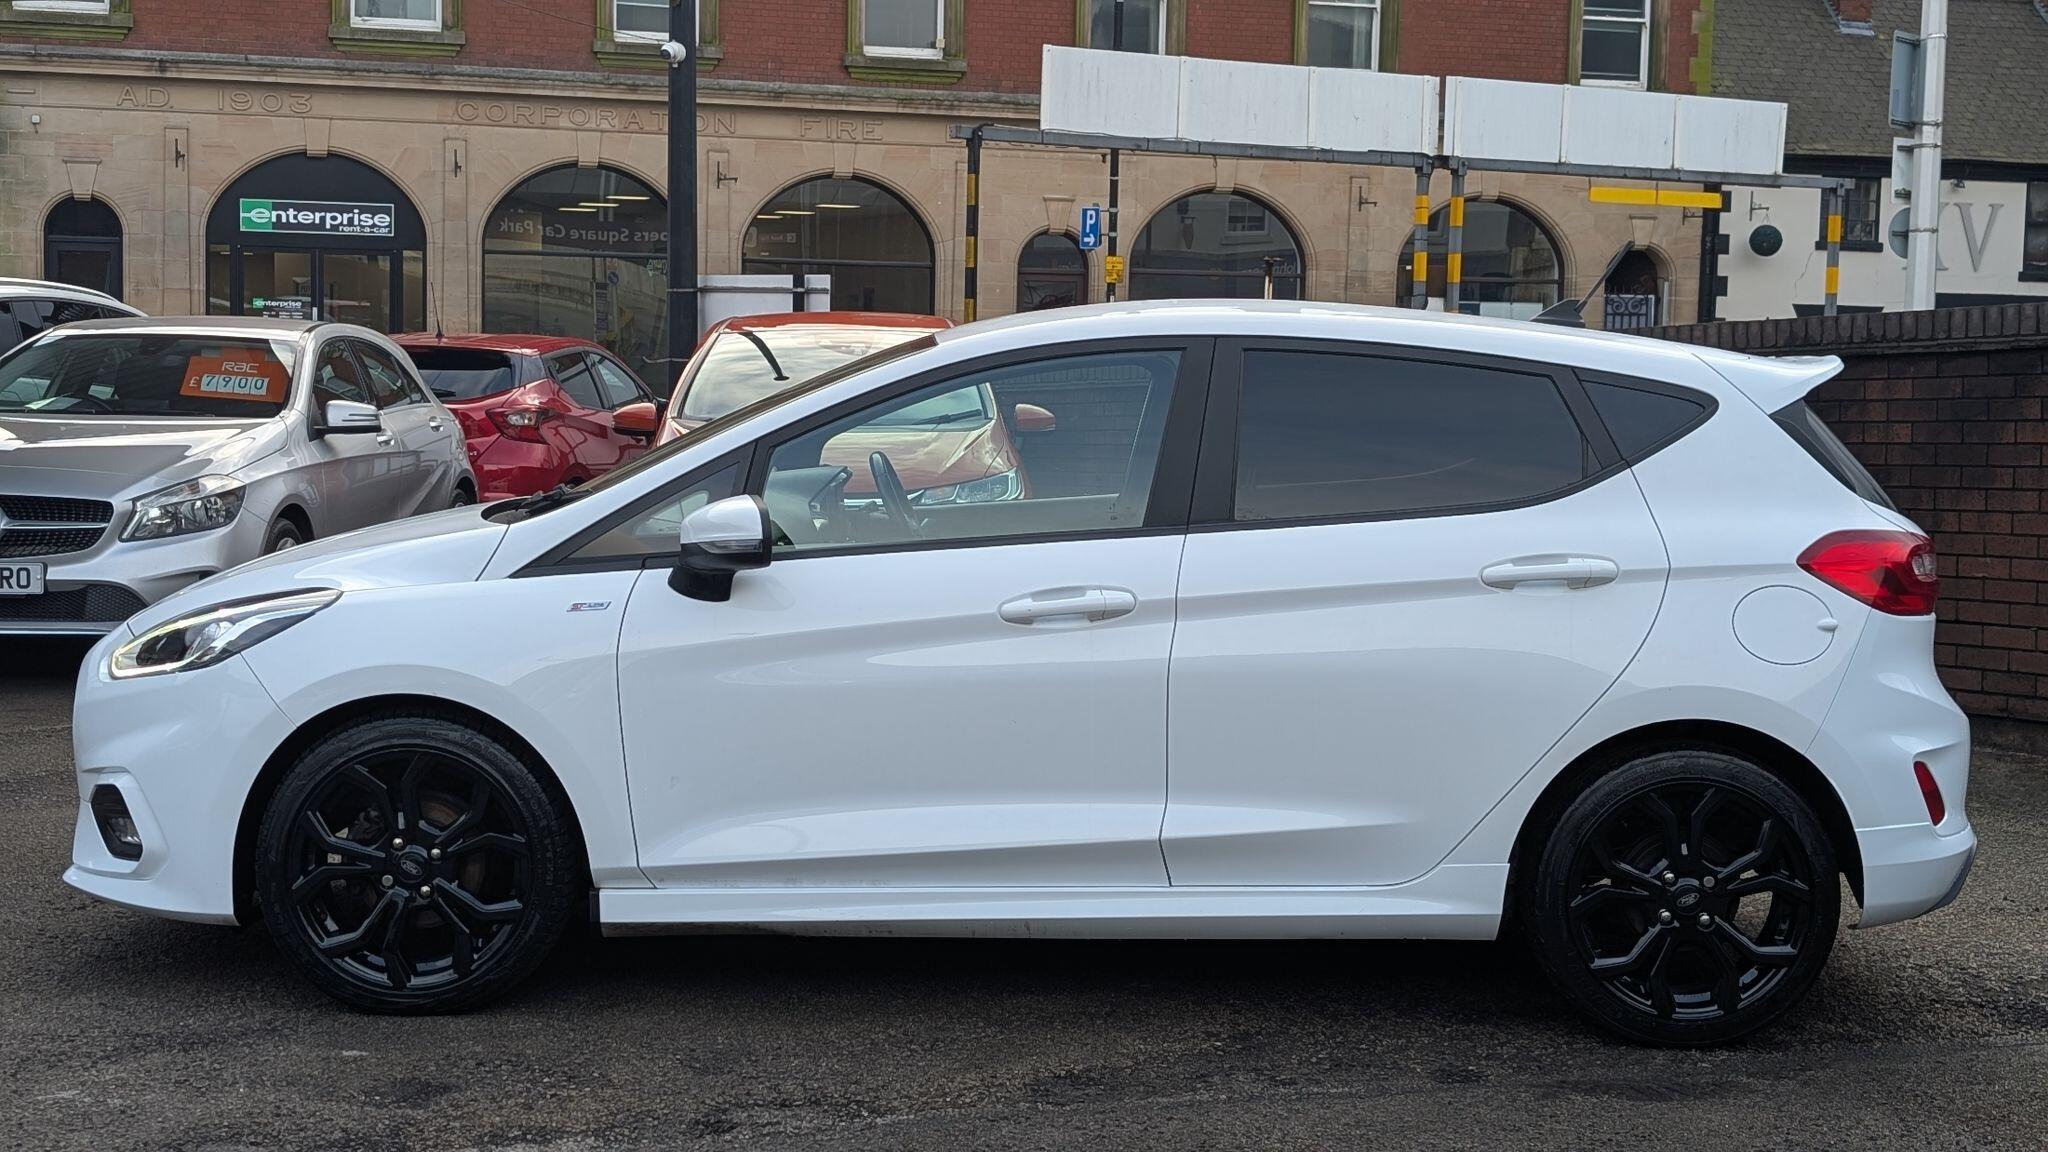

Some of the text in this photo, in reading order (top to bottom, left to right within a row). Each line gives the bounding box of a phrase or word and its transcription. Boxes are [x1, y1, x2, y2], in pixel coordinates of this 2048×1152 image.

[217, 89, 313, 114] 1903
[455, 101, 737, 135] CORPORATON
[800, 116, 884, 142] FIRE
[241, 207, 391, 229] enterprise
[338, 224, 391, 234] rent-a-car
[1085, 209, 1097, 234] P
